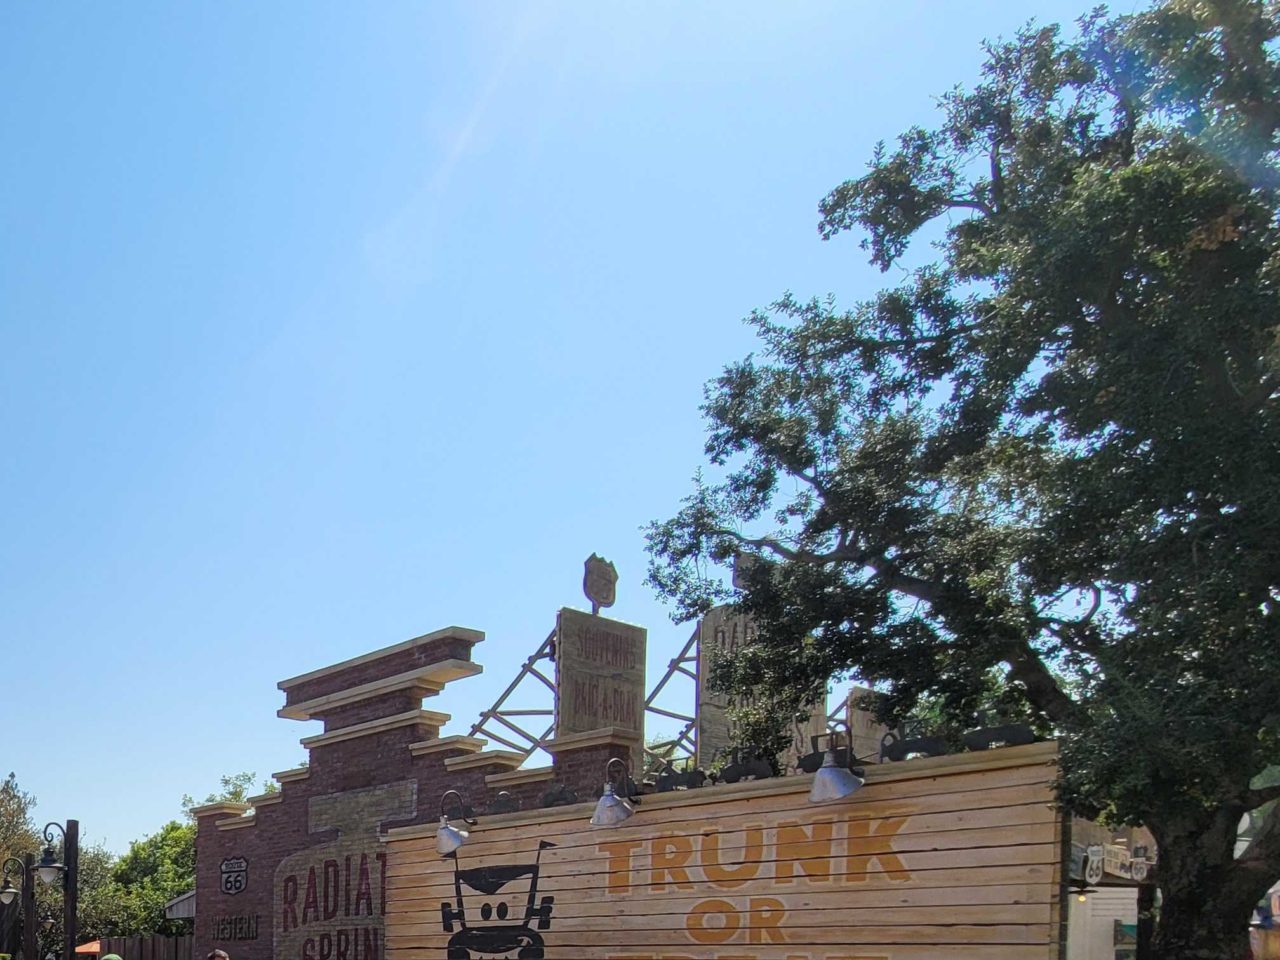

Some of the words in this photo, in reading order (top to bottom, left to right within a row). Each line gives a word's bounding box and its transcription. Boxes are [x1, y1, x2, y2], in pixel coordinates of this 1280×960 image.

[598, 815, 911, 894] TRUNK
[1088, 860, 1101, 878] 66
[225, 873, 242, 891] 66
[686, 897, 789, 944] OR
